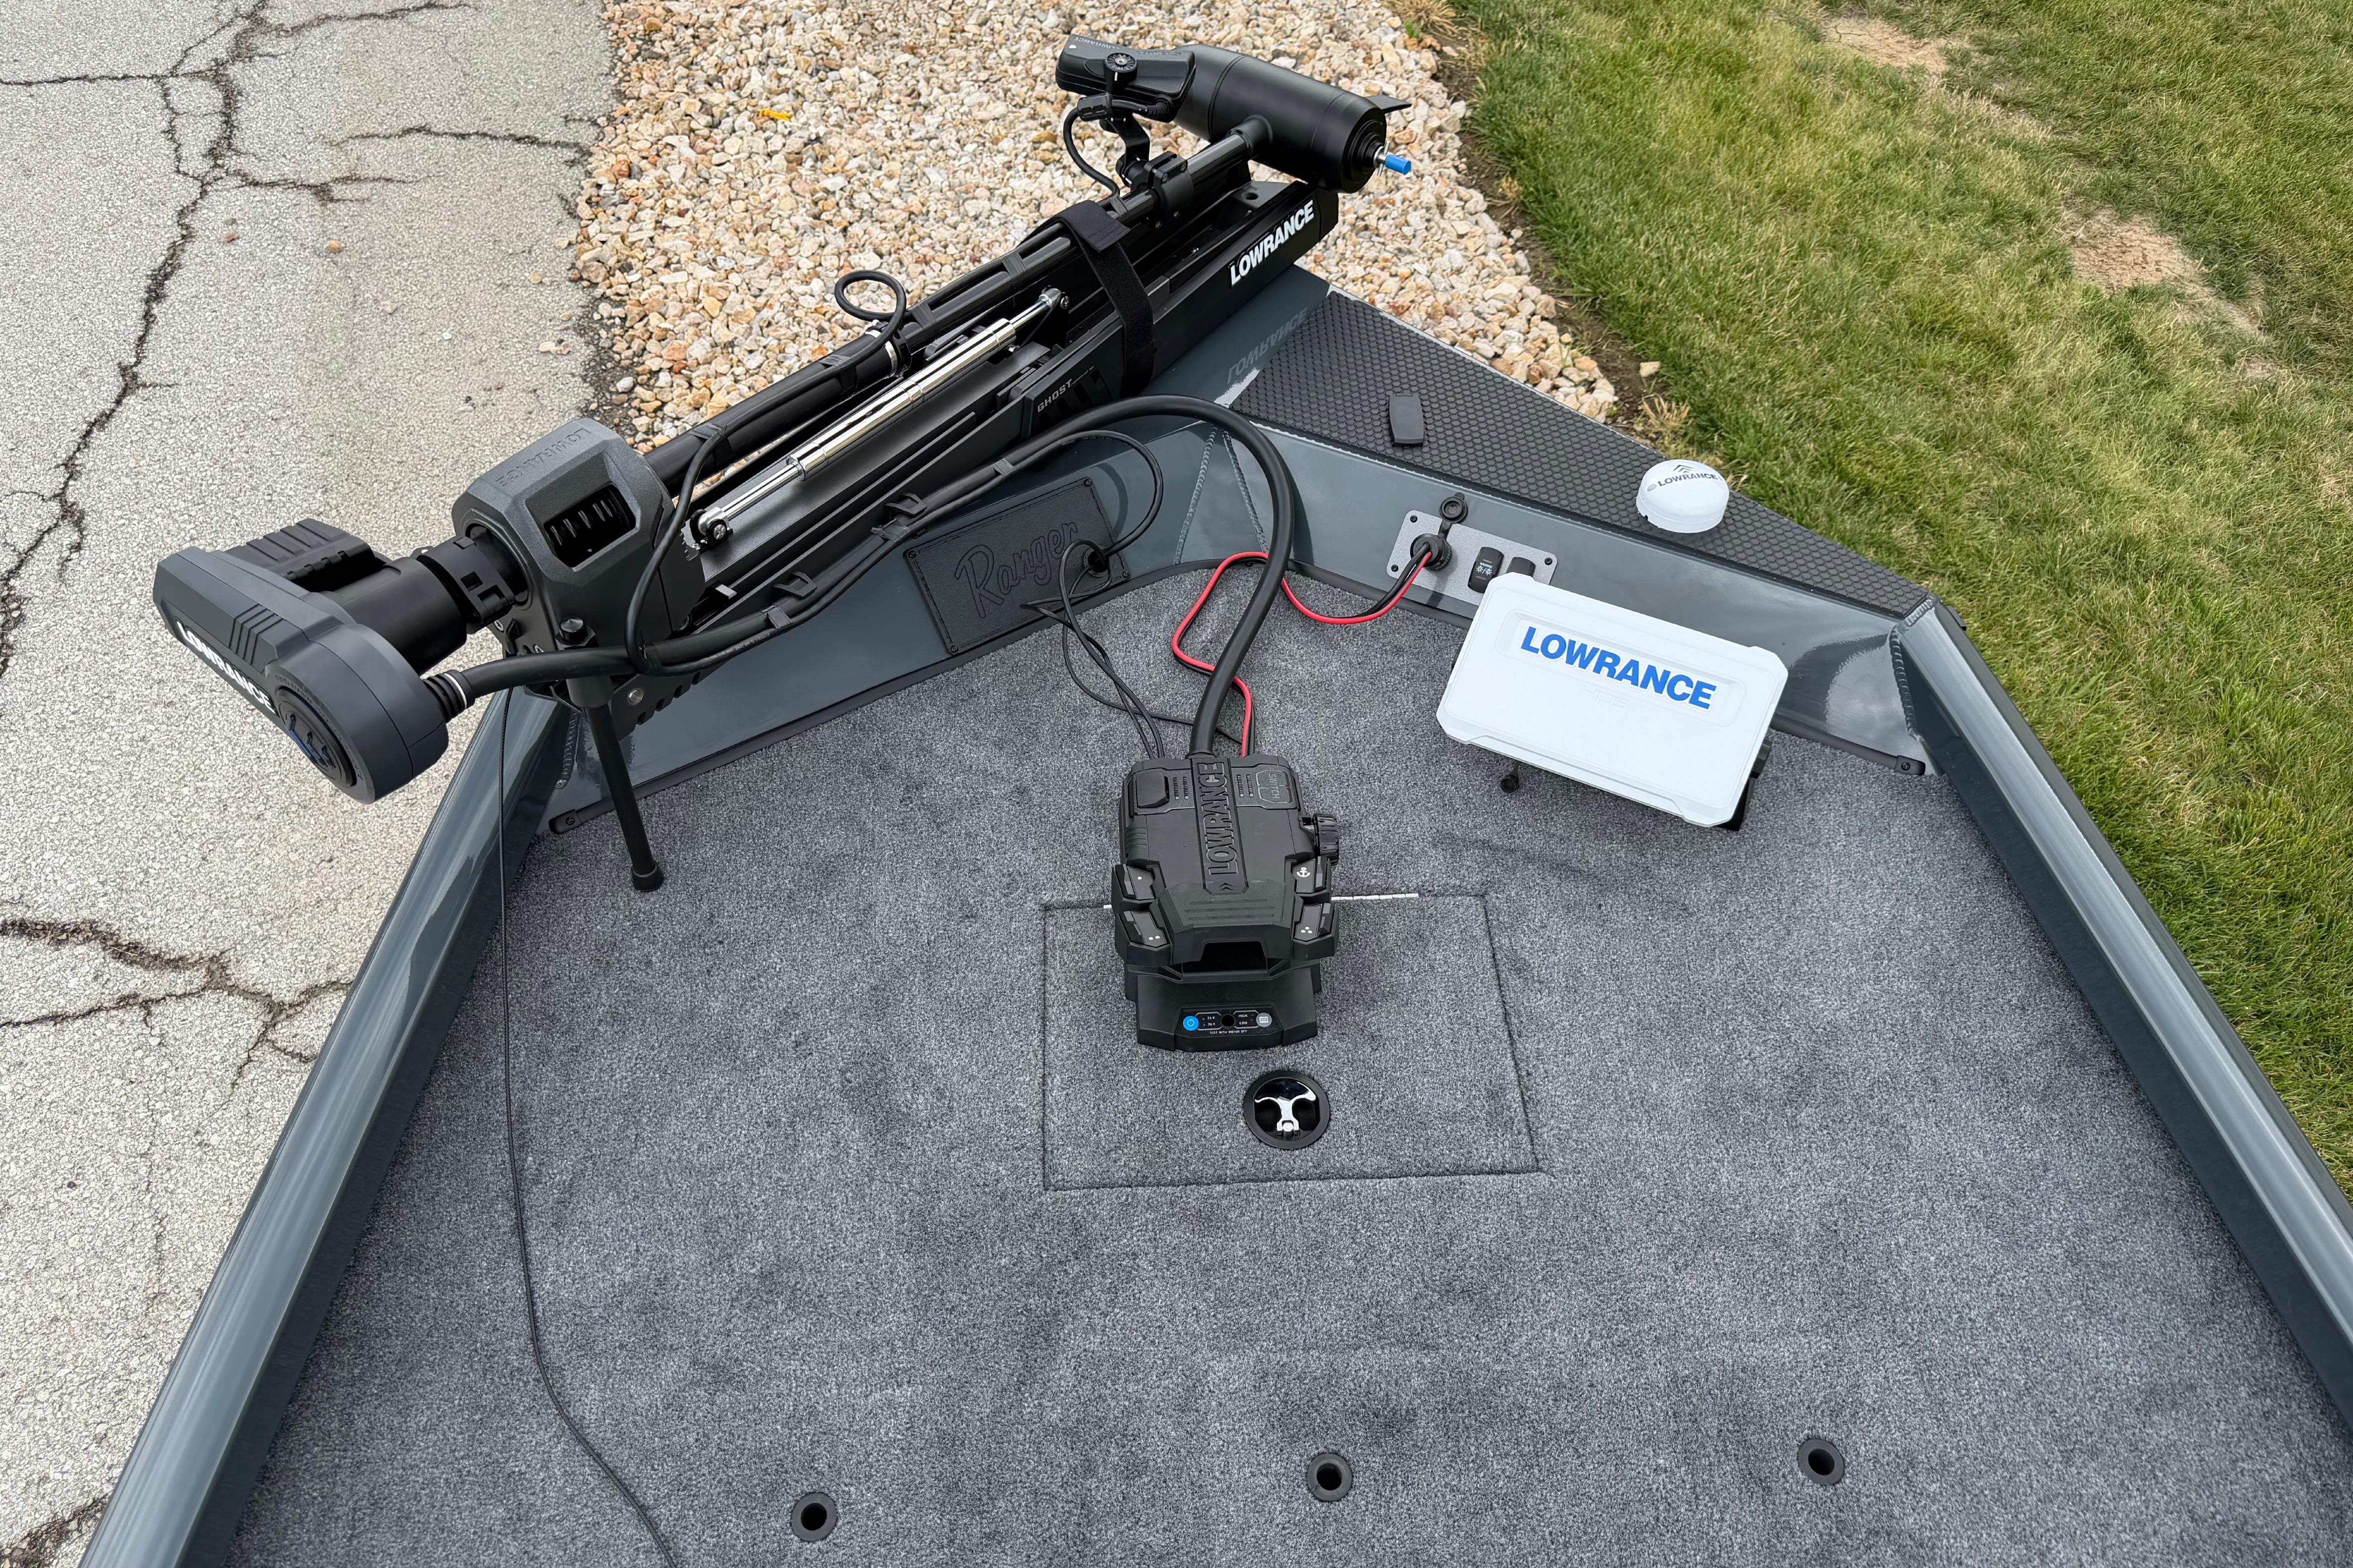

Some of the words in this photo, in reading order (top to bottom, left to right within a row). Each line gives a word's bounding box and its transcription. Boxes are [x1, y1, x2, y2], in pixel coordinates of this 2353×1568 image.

[1230, 199, 1314, 286] LOWRANCE
[1037, 379, 1072, 412] GHOST
[495, 427, 592, 487] LOWRANCE
[1657, 473, 1718, 487] LOWRANCE
[954, 522, 1078, 618] Ranger
[177, 621, 276, 714] LOWRANCE
[1521, 626, 1717, 710] LOWRANCE
[1197, 762, 1238, 875] LOWRANCE
[1269, 773, 1280, 798] SWITCH
